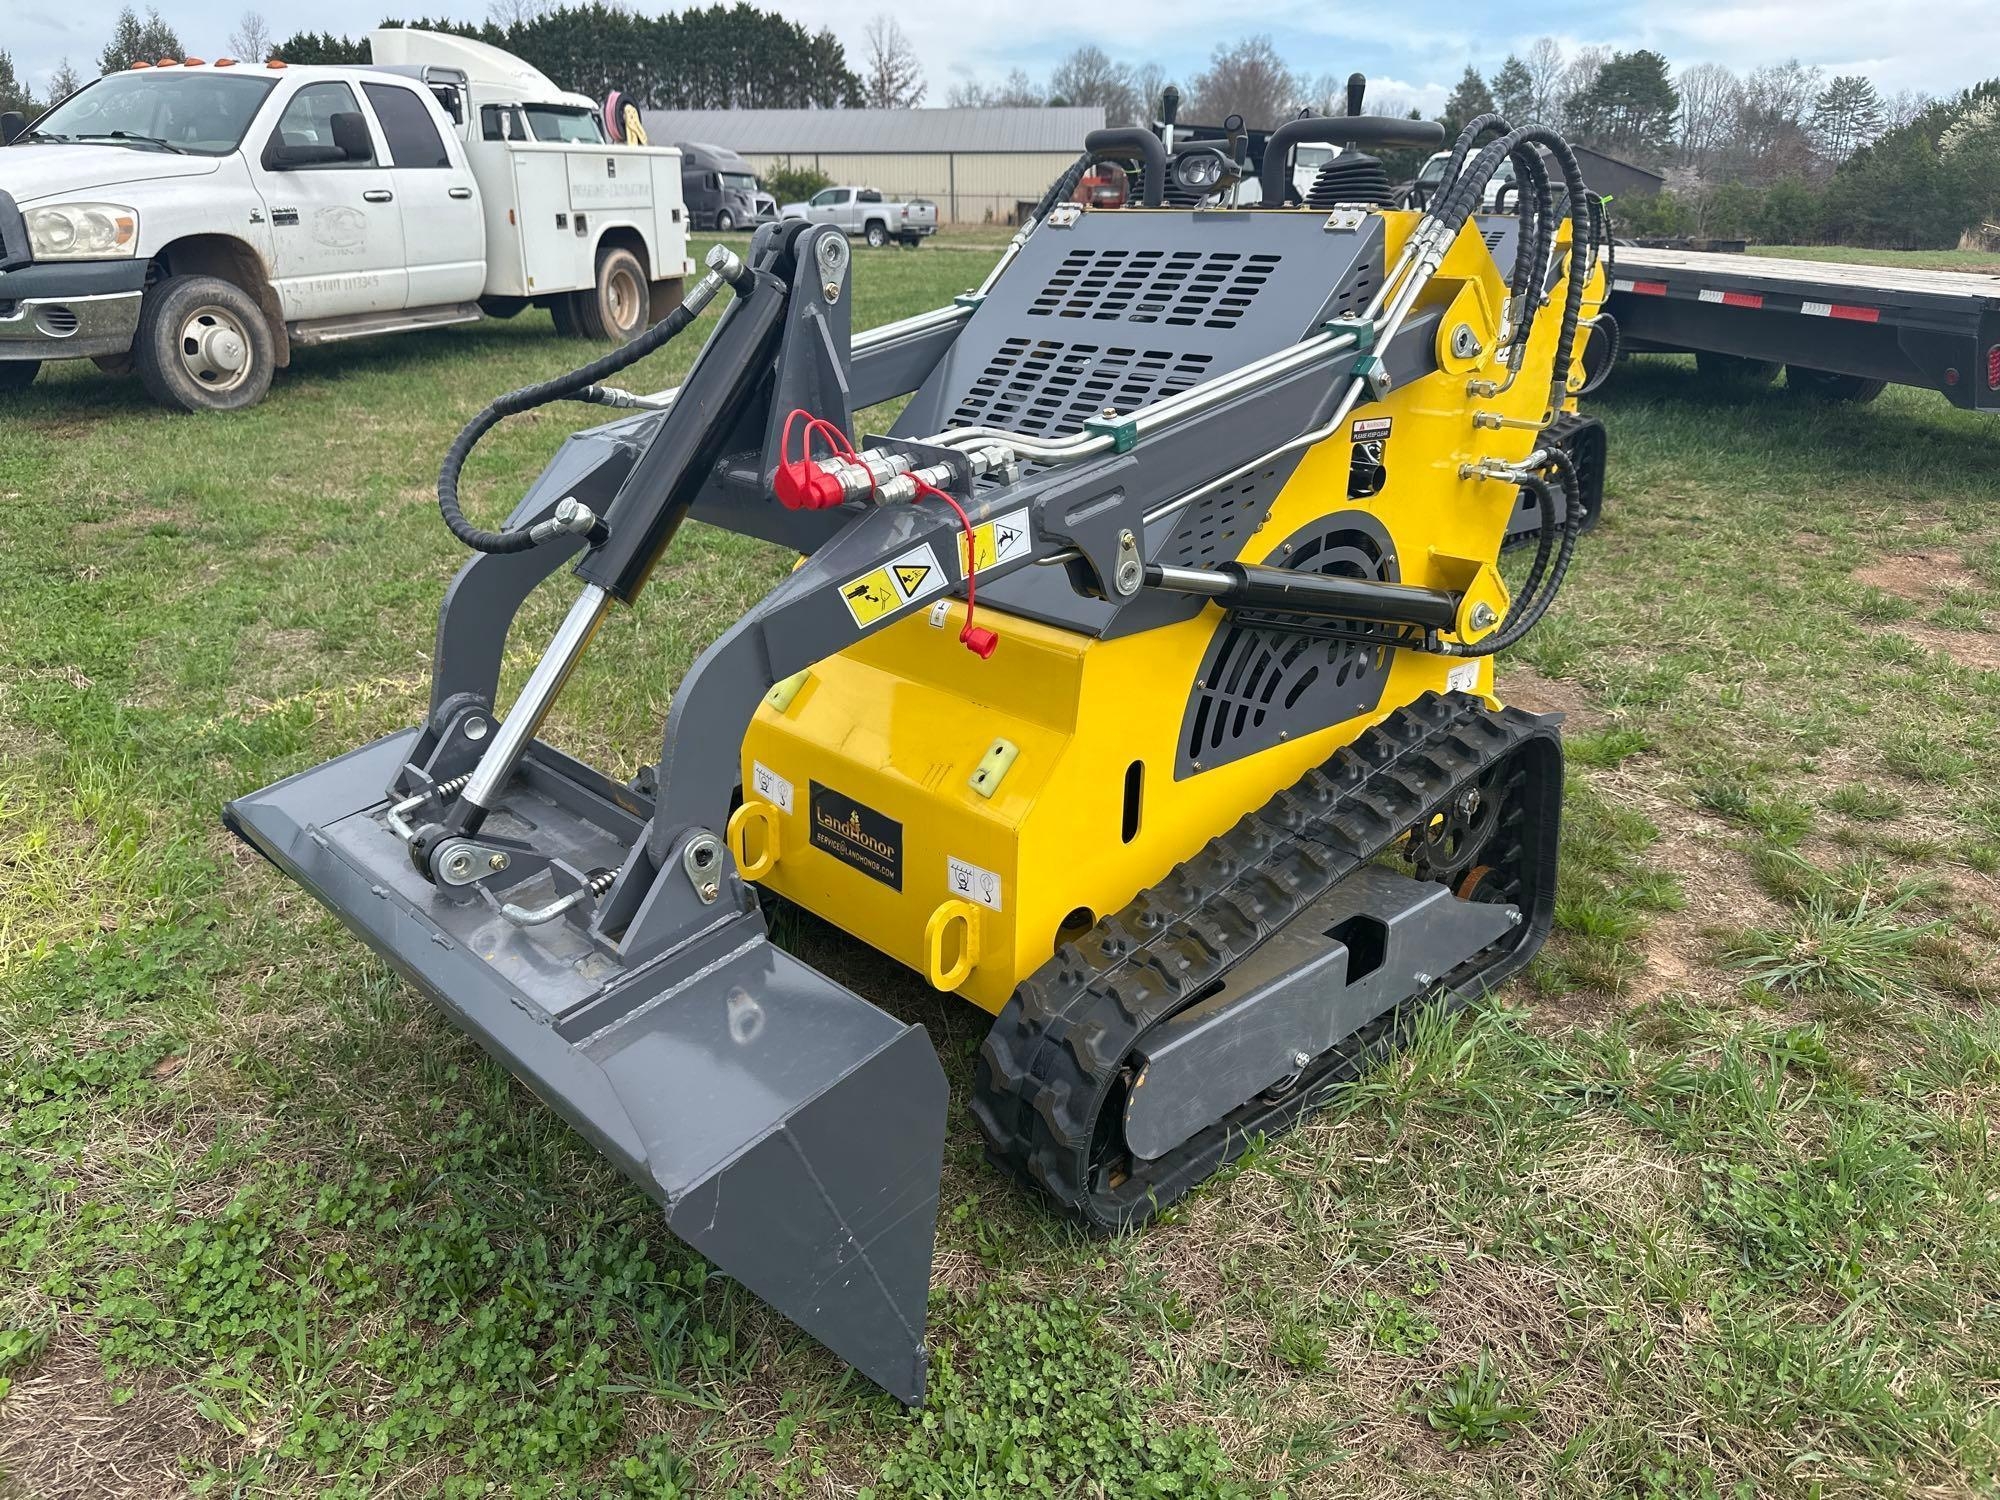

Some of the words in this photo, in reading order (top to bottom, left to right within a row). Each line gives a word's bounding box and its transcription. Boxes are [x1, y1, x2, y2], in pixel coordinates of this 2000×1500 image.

[1353, 432, 1367, 440] PLEASE
[816, 806, 895, 857] LandHonor
[816, 832, 895, 879] SERVICE@LANDHONOR.COM
